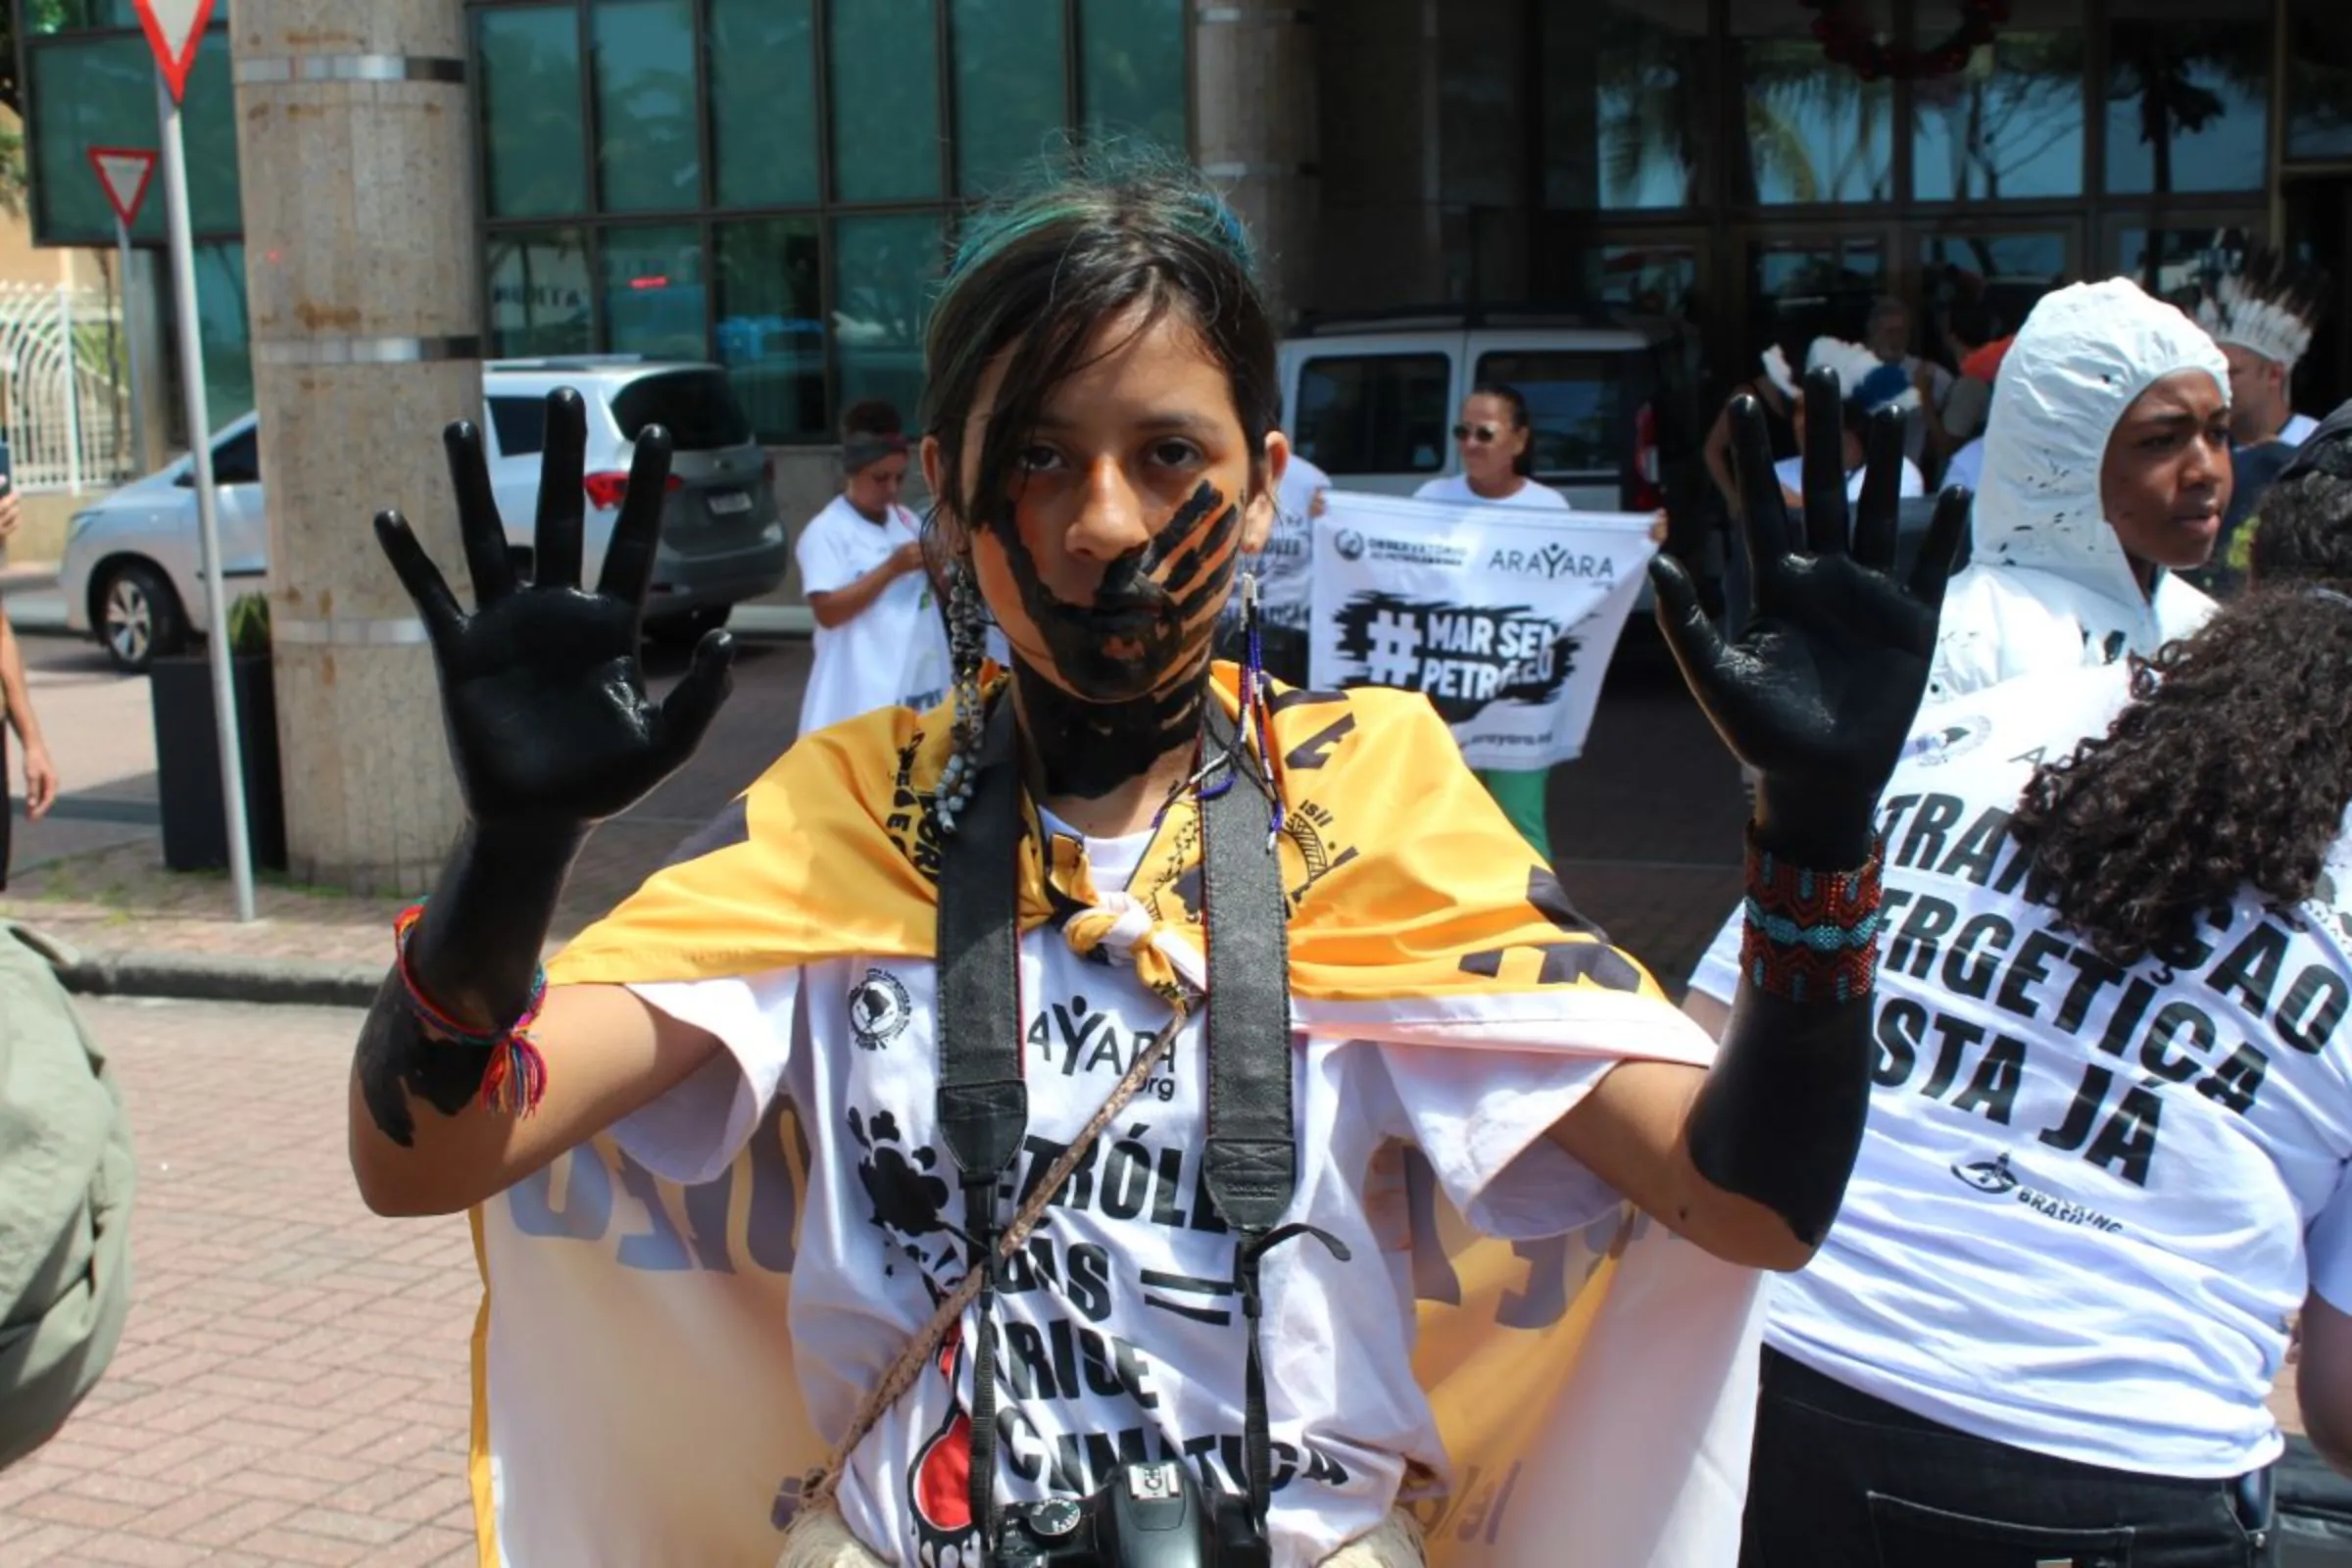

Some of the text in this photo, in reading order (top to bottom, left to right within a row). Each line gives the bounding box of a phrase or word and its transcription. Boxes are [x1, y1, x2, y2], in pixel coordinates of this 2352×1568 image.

[1488, 542, 1615, 579] ARAYARA
[1427, 613, 1494, 656] MAR
[2038, 1063, 2168, 1188] JÁ
[993, 1319, 1159, 1409] RISE
